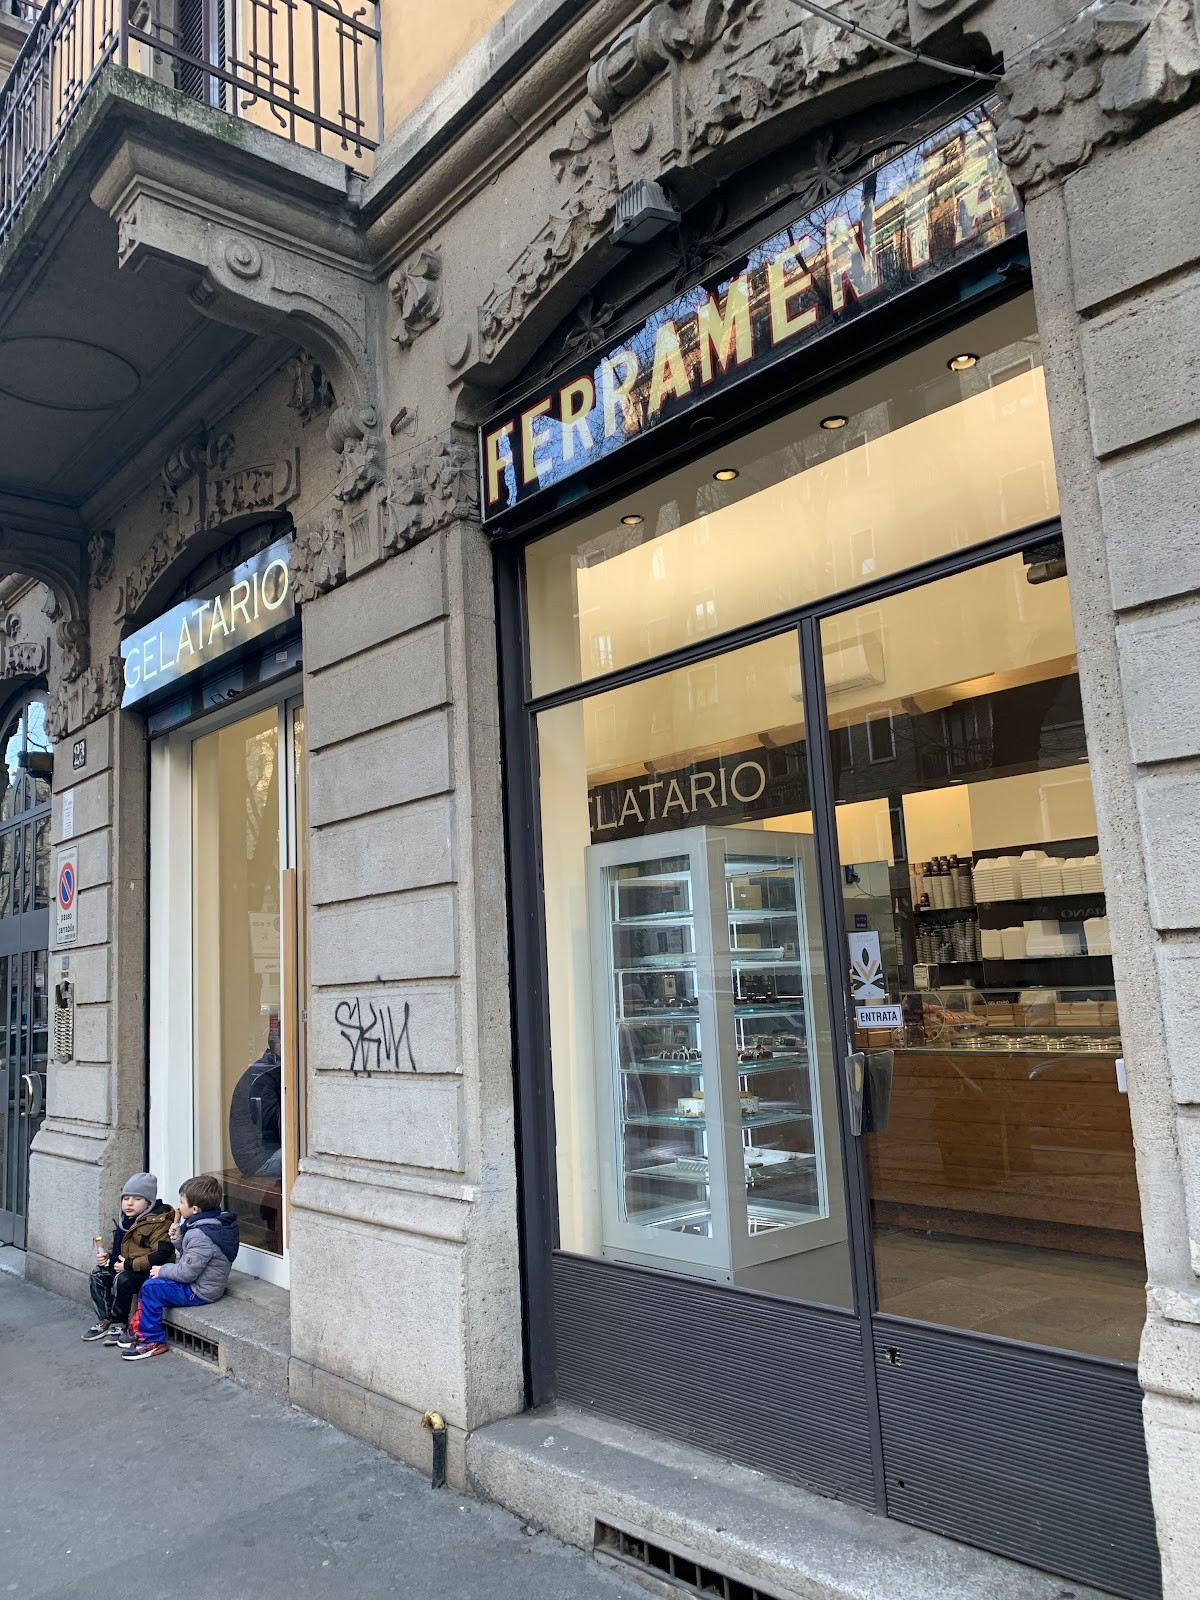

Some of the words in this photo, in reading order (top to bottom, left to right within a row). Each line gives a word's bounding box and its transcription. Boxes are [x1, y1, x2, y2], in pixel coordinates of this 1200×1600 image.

[485, 118, 1024, 507] FERRAMENTA
[123, 558, 289, 689] GELATARIO
[860, 1011, 898, 1022] ENTRATA
